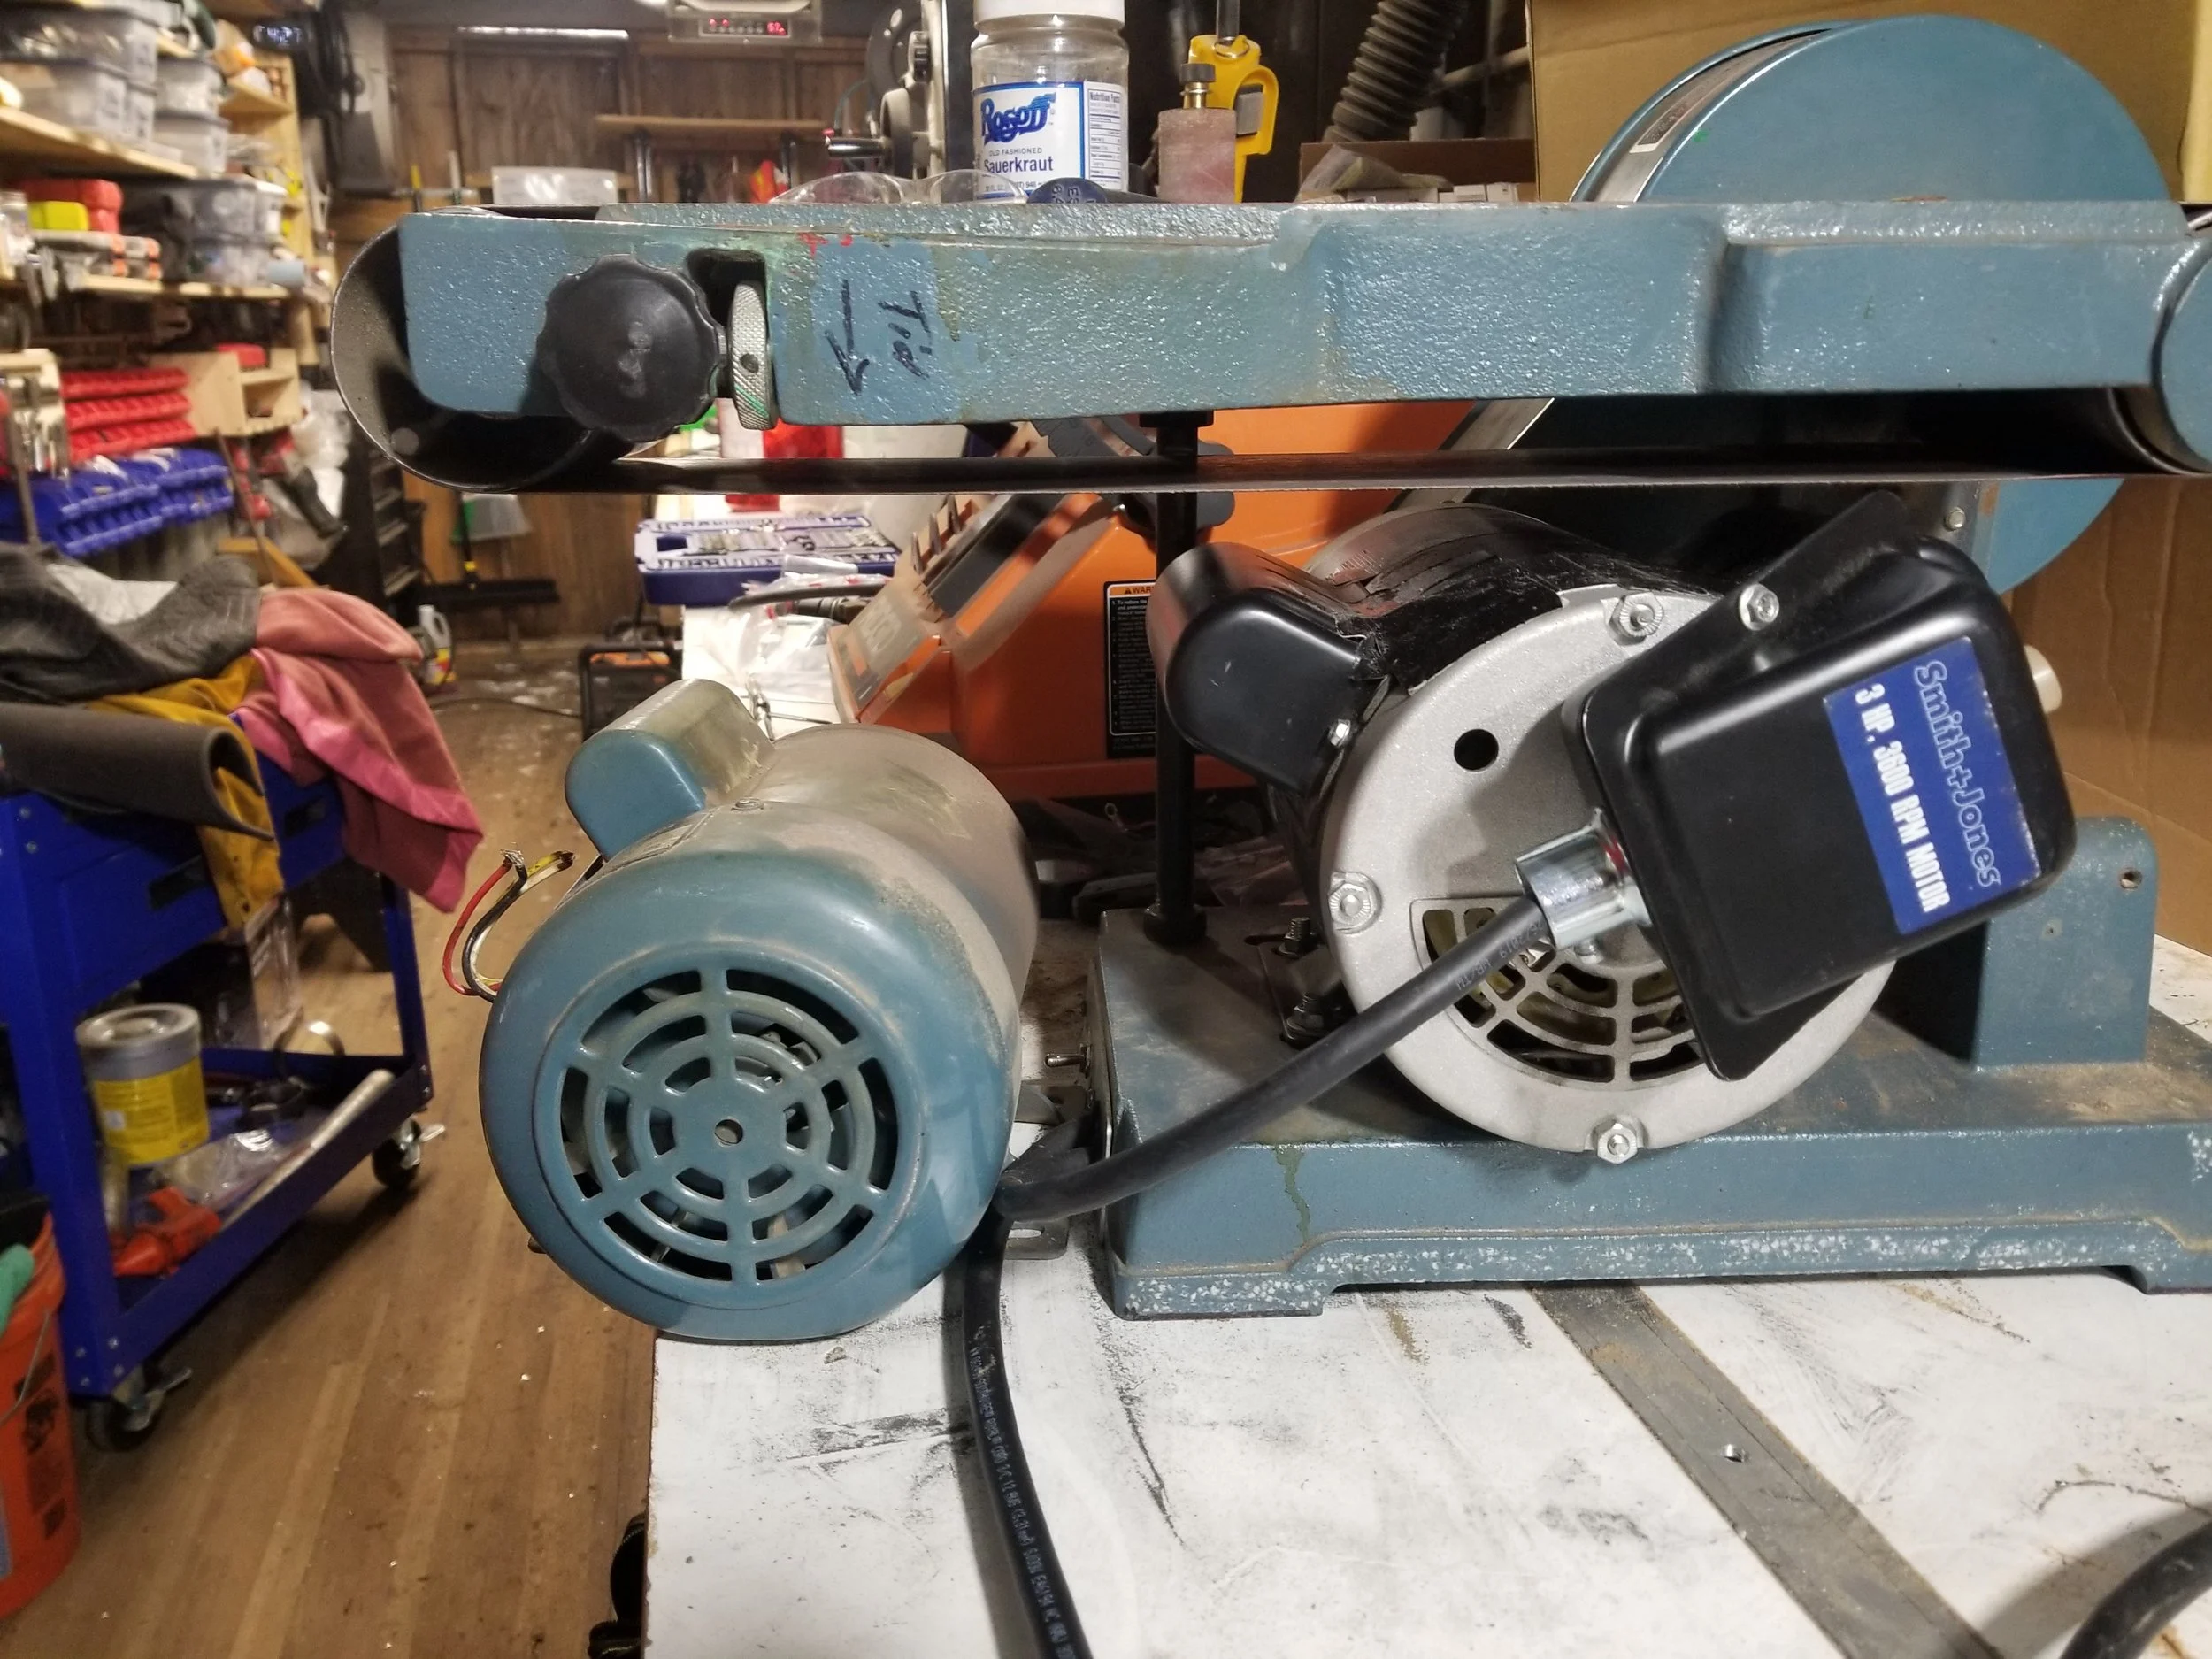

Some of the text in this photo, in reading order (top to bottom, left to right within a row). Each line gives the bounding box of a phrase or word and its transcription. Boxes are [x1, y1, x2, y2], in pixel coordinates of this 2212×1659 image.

[984, 156, 1054, 174] Sauerkraut
[1002, 147, 1043, 156] FASHIONED
[1855, 683, 1951, 913] 3 HP. 3600 RPM MOTOR
[1914, 660, 2001, 887] Smith+Jones
